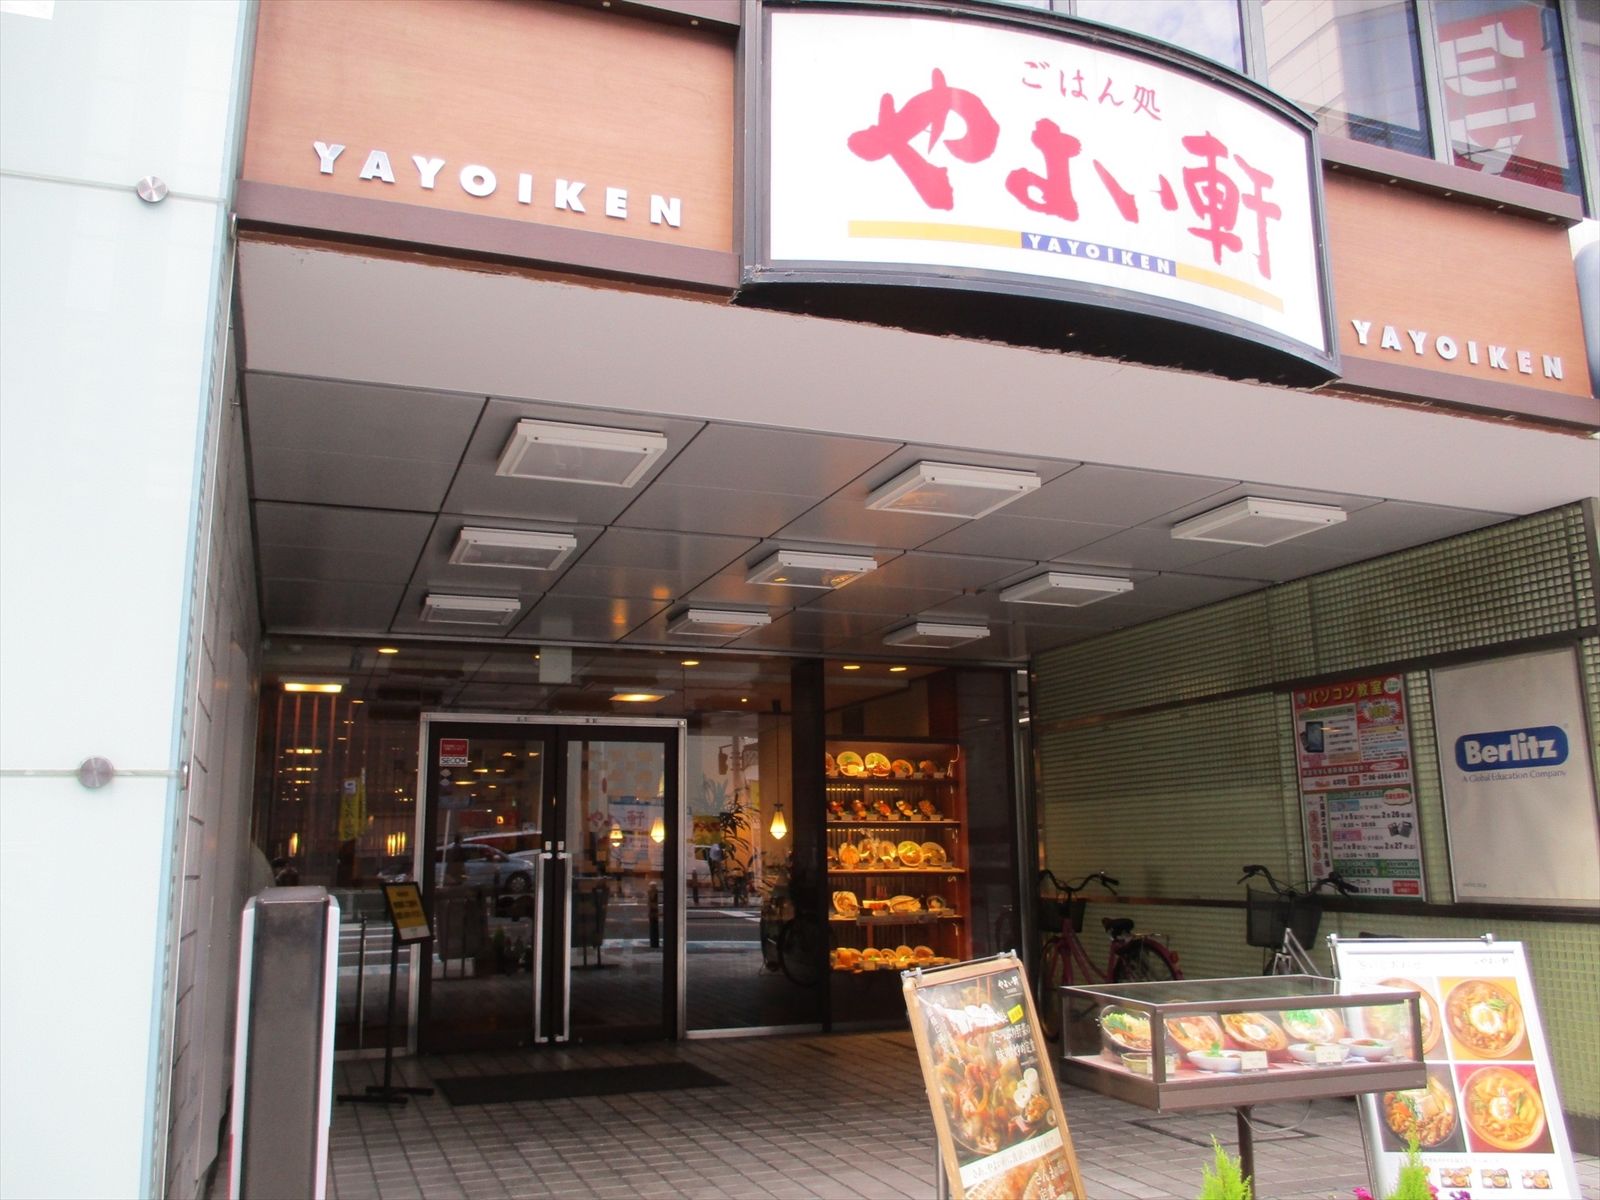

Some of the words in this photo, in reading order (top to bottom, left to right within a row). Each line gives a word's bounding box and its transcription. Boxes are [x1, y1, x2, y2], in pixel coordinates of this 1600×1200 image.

[1022, 60, 1163, 121] ごはん処
[312, 141, 682, 229] YAYOIKEN
[847, 68, 1283, 280] やよい軒
[1025, 234, 1172, 274] YAYOIKEN
[1351, 320, 1563, 379] YAYOIKEN
[1308, 680, 1382, 704] パソコン教室
[1463, 732, 1558, 765] Berlitz
[1491, 771, 1528, 781] Education
